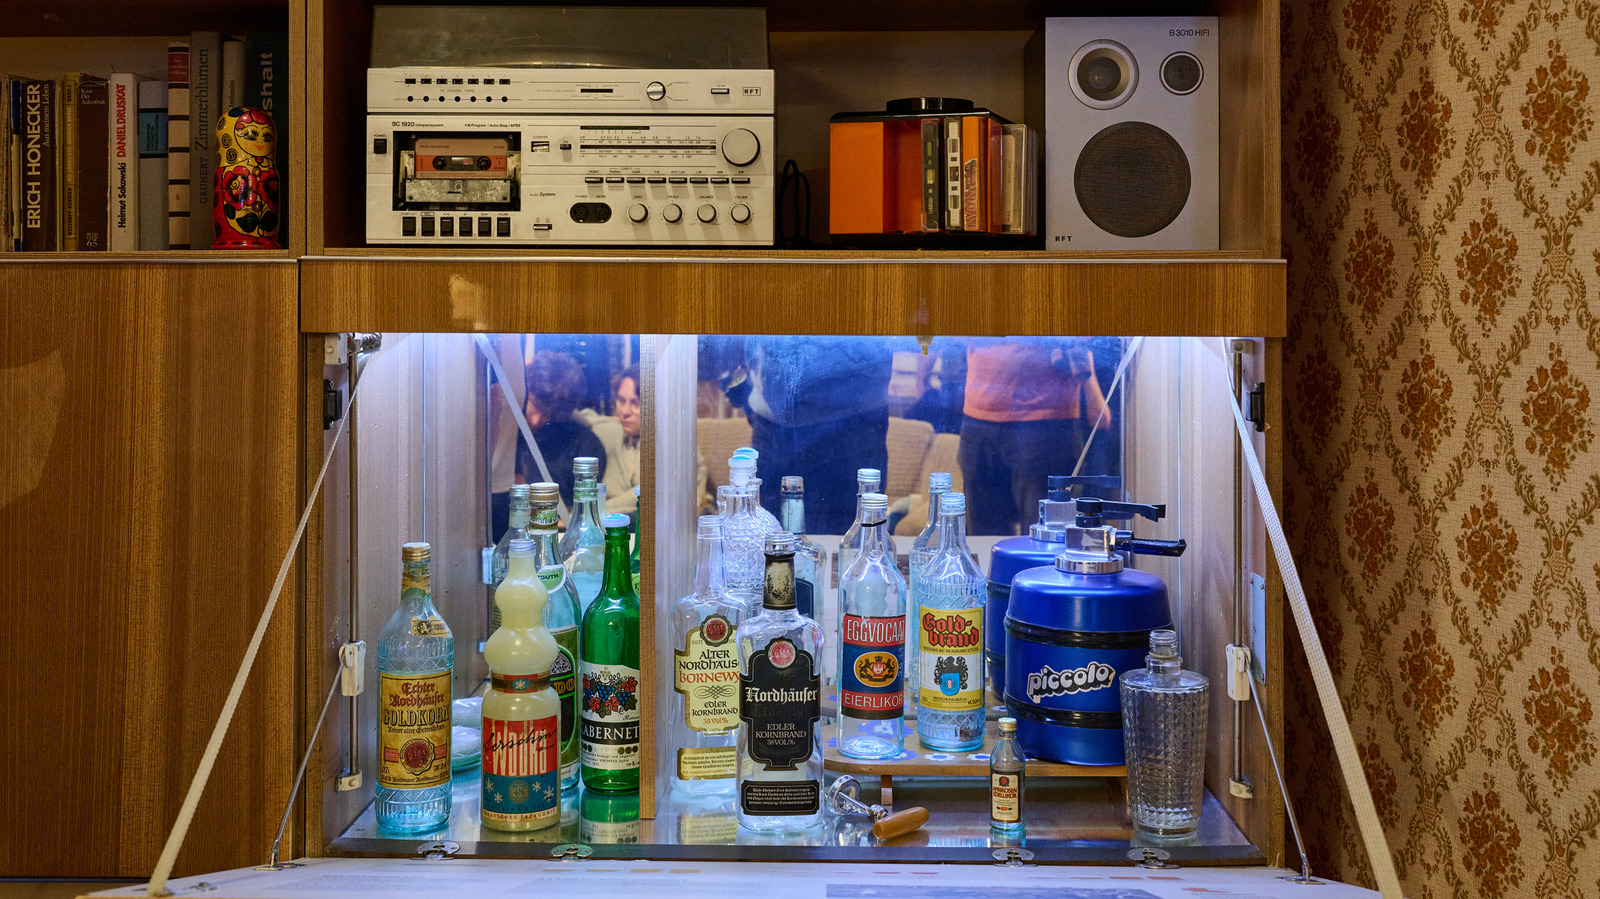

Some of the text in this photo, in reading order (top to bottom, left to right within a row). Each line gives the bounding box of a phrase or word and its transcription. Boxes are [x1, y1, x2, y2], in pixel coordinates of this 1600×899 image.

[1169, 29, 1175, 37] B
[1175, 29, 1194, 37] 3010
[260, 52, 273, 116] shalt
[194, 49, 209, 151] Zimmerblumen
[26, 84, 41, 229] ERICH HONECKER
[116, 83, 127, 228] Helmut Sakowski DANIEL DRUSKAT
[86, 240, 98, 248] 65
[922, 612, 973, 634] Gold-
[928, 626, 980, 648] brand
[699, 649, 731, 660] ALTER
[679, 659, 740, 671] NORDHÄUS
[401, 681, 436, 697] Echter
[1028, 662, 1116, 702] piccolo
[704, 701, 727, 709] EDLER
[844, 692, 903, 708] EIERLIKÖR
[692, 707, 739, 717] KORNBRAND
[767, 723, 796, 731] EDLER
[755, 731, 807, 739] KORNBRAND
[483, 807, 556, 820] DEUTSCHES ERZEUGNIS
